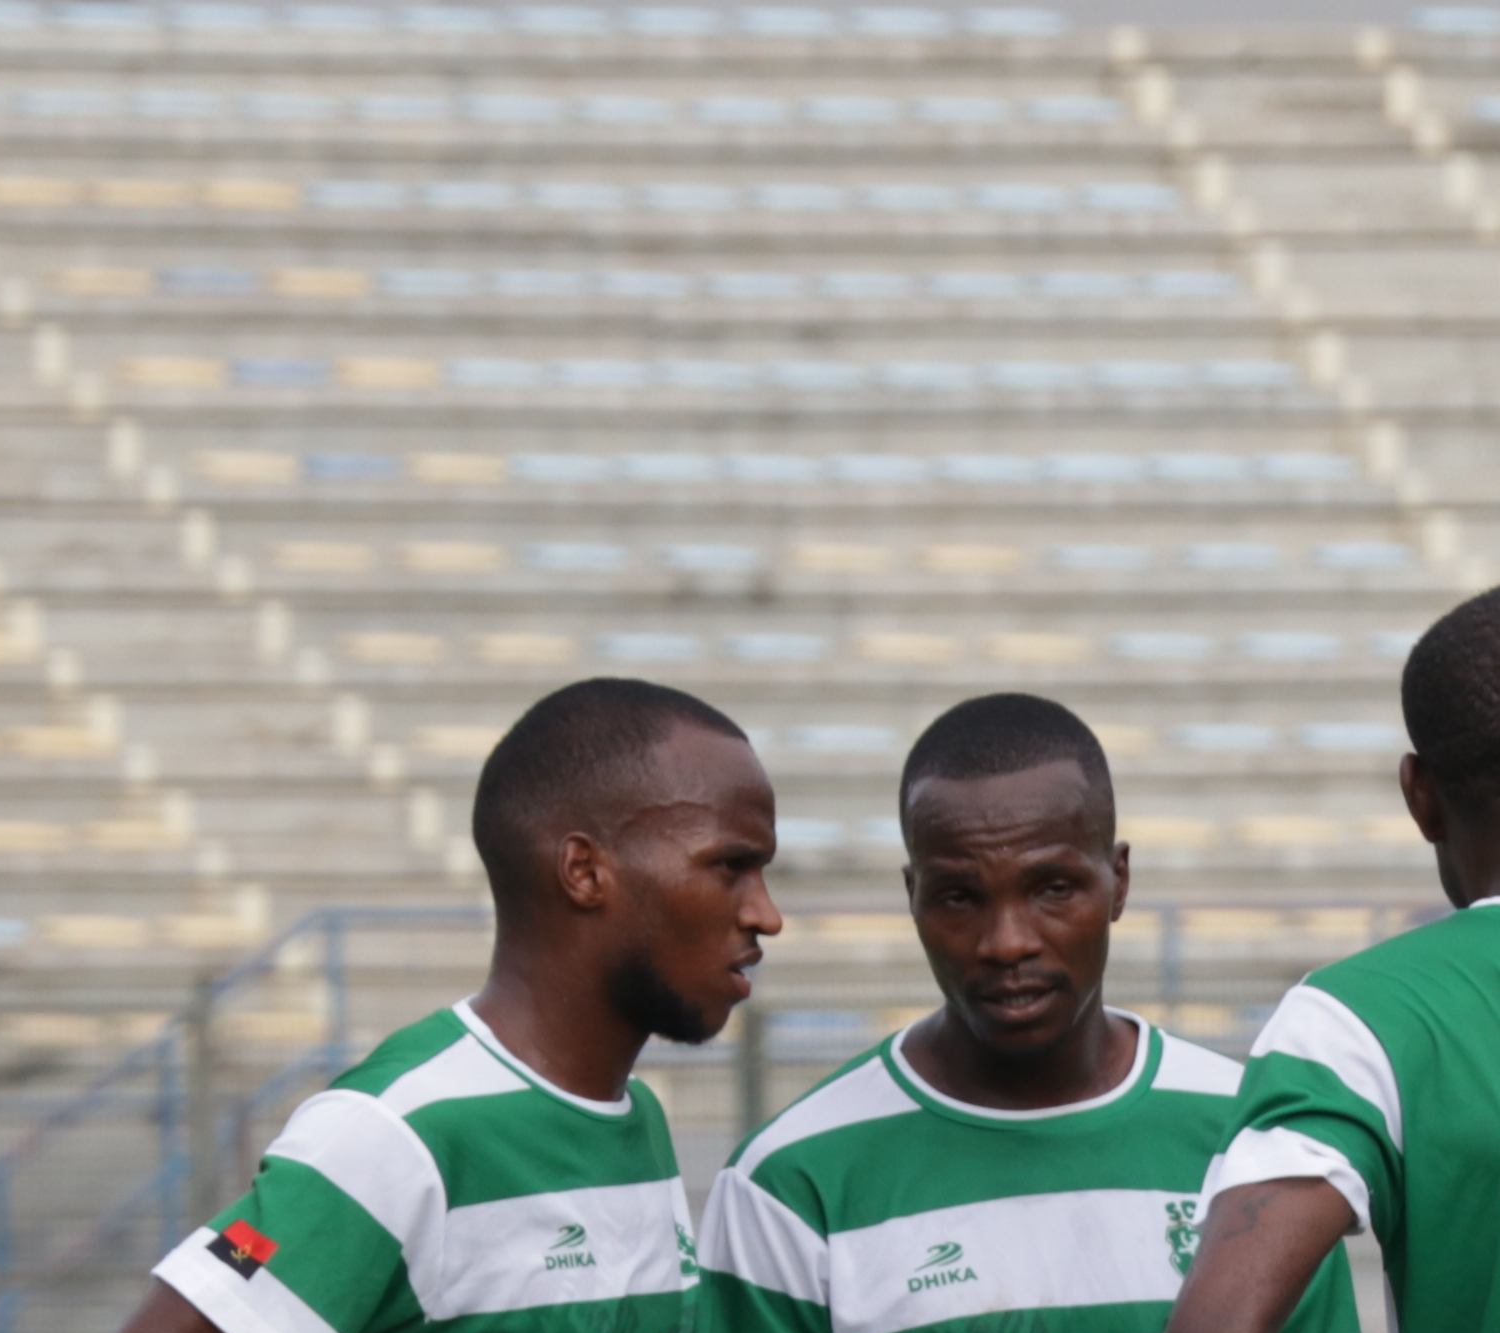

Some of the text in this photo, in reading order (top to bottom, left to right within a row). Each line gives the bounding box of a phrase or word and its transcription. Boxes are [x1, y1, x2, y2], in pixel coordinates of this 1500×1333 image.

[1165, 1200, 1198, 1222] SC
[544, 1251, 597, 1271] DHIKA
[906, 1266, 978, 1293] DHIKA
